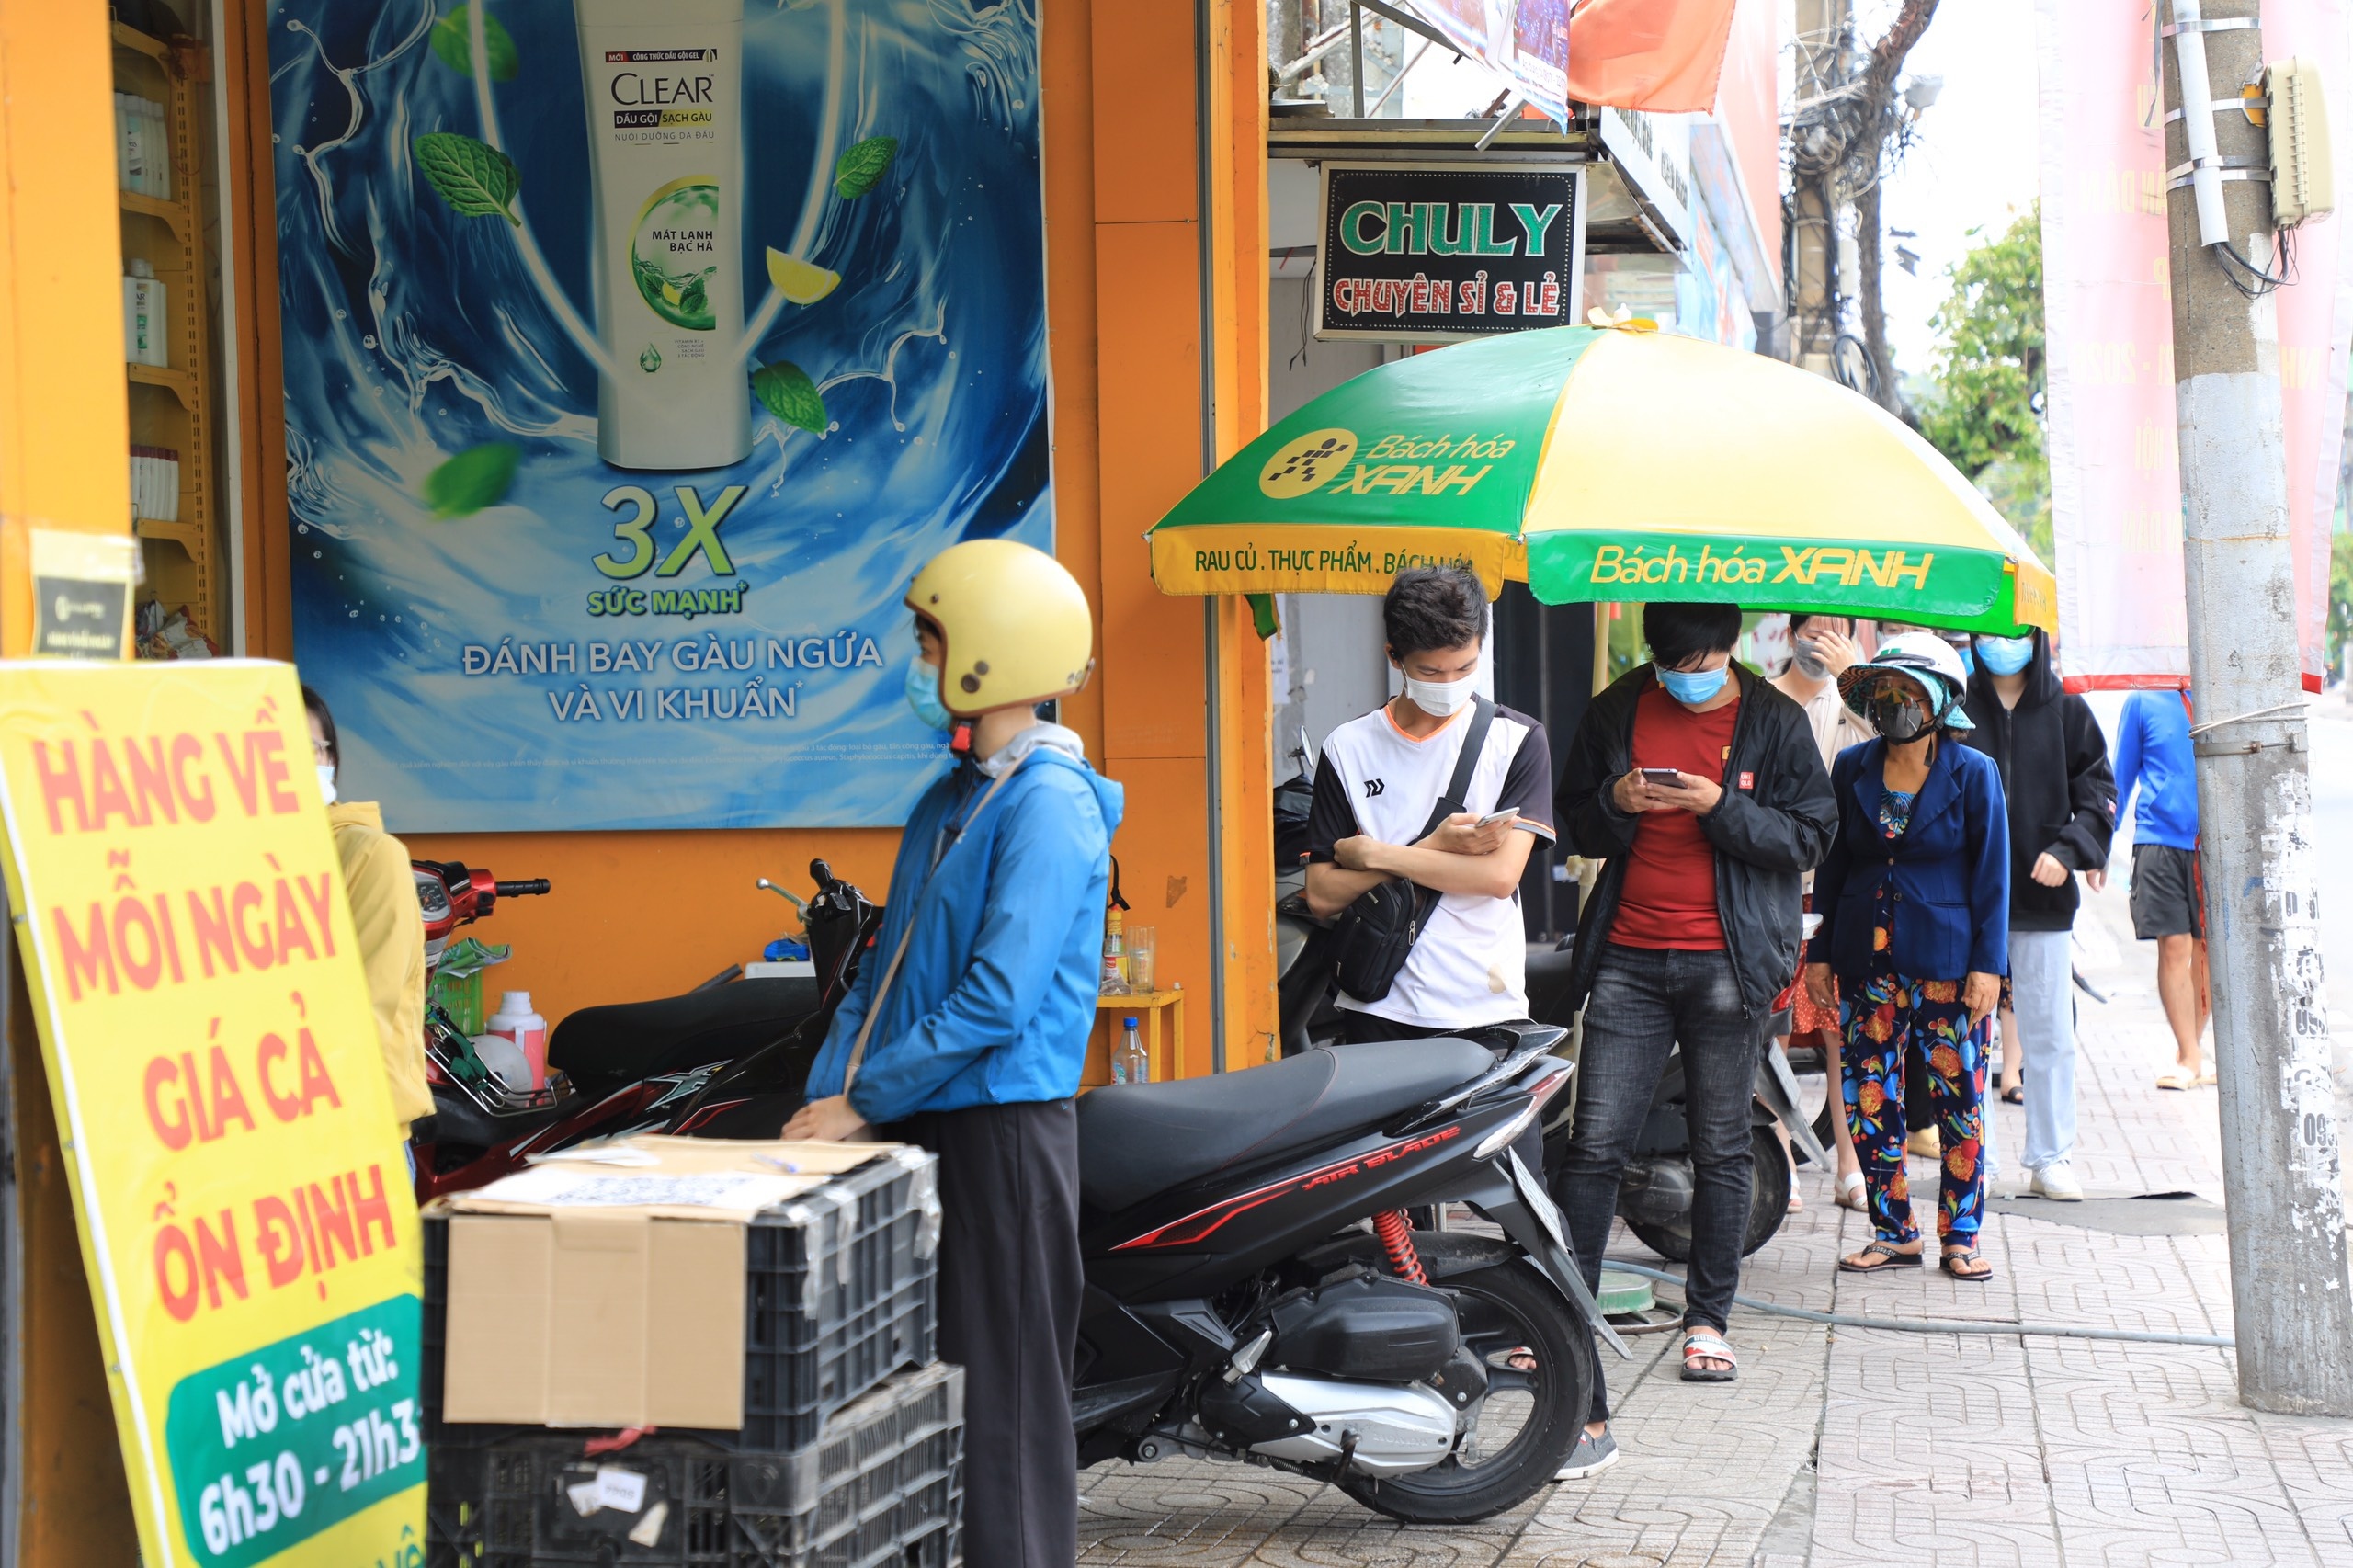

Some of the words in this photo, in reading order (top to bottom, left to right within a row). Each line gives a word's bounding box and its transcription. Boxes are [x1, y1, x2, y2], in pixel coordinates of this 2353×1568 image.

[632, 52, 649, 61] CÔNG
[611, 73, 713, 106] CLEAR
[614, 132, 638, 142] NUÔI
[642, 131, 676, 141] DƯỠNG
[679, 131, 692, 140] DA
[639, 112, 658, 125] GỘI
[662, 113, 688, 124] SẠCH
[690, 111, 712, 122] GÀU
[652, 229, 677, 240] MÁT
[680, 230, 713, 243] LẠNH
[669, 242, 693, 254] BẠC
[697, 240, 713, 252] HÀ
[1339, 200, 1563, 256] CHULY
[1334, 273, 1452, 318] CHUYÊN
[1459, 270, 1488, 316] SỈ
[1494, 281, 1517, 315] &
[1522, 271, 1561, 317] LẺ
[1366, 434, 1451, 458] Bách
[1449, 433, 1516, 458] hóa
[1327, 464, 1493, 495] XANH
[591, 484, 749, 580] 3X
[1195, 551, 1230, 571] RAU
[1234, 541, 1257, 571] CỦ
[1267, 550, 1315, 576] THỰC
[1320, 540, 1372, 573] PHẨM
[1590, 544, 1688, 585] Bách
[1697, 544, 1767, 585] hóa
[1771, 545, 1935, 591] XANH
[587, 585, 646, 617] SỨC
[462, 636, 576, 676] ĐÁNH
[588, 641, 663, 672] BAY
[671, 633, 755, 671] GÀU
[767, 630, 883, 669] NGỨA
[548, 684, 602, 722] VÀ
[608, 690, 644, 720] VI
[32, 710, 217, 835] HÀNG
[214, 696, 301, 818] VỀ
[51, 849, 184, 1003] MỖI
[187, 852, 337, 980] NGÀY
[142, 1017, 256, 1153] GIÁ
[256, 991, 344, 1124] CẢ
[1302, 1164, 1359, 1191] AIR
[1364, 1126, 1461, 1169] BLADE
[152, 1182, 250, 1324] ỔN
[252, 1164, 399, 1304] ĐỊNH
[215, 1363, 278, 1449] Mở
[281, 1345, 348, 1422] cửa
[199, 1449, 307, 1557] 6h30
[332, 1397, 425, 1494] 21h3
